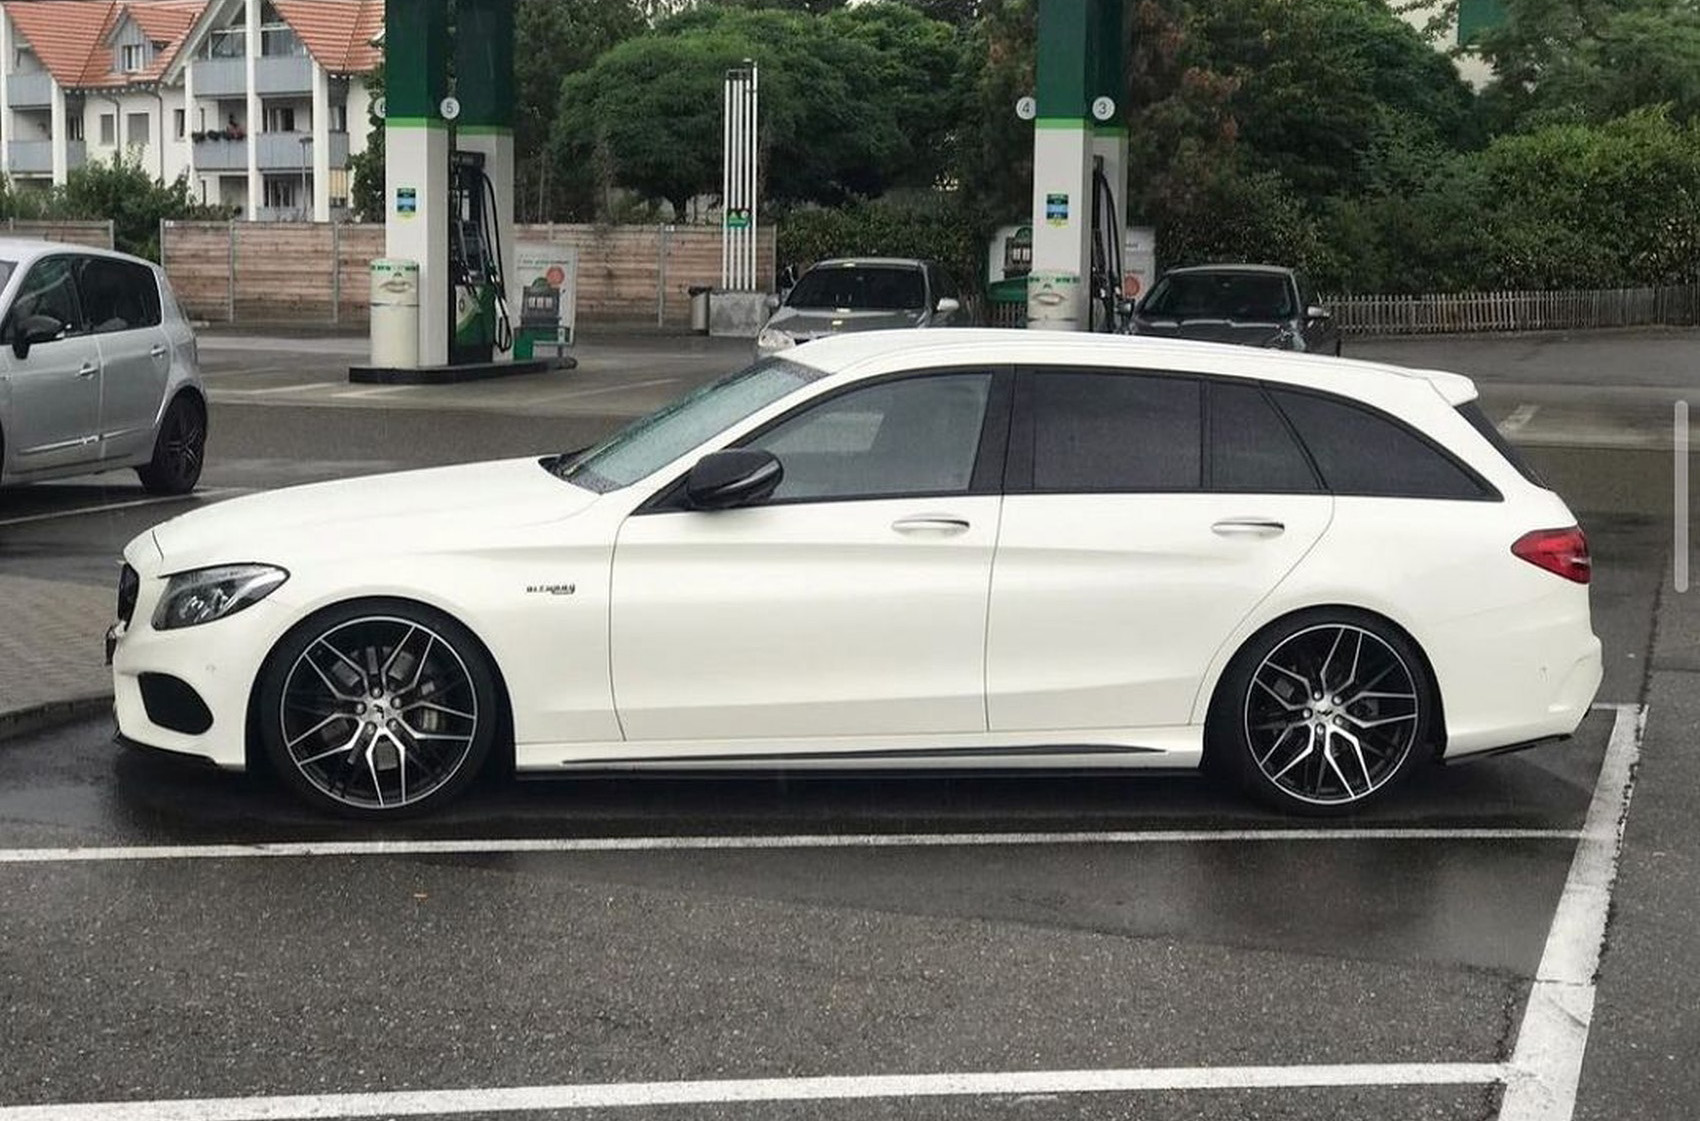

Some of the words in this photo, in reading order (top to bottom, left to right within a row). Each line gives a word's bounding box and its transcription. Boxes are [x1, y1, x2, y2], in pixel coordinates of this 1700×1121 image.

[446, 101, 454, 114] 5
[1022, 101, 1030, 113] 4
[1098, 101, 1107, 115] 3
